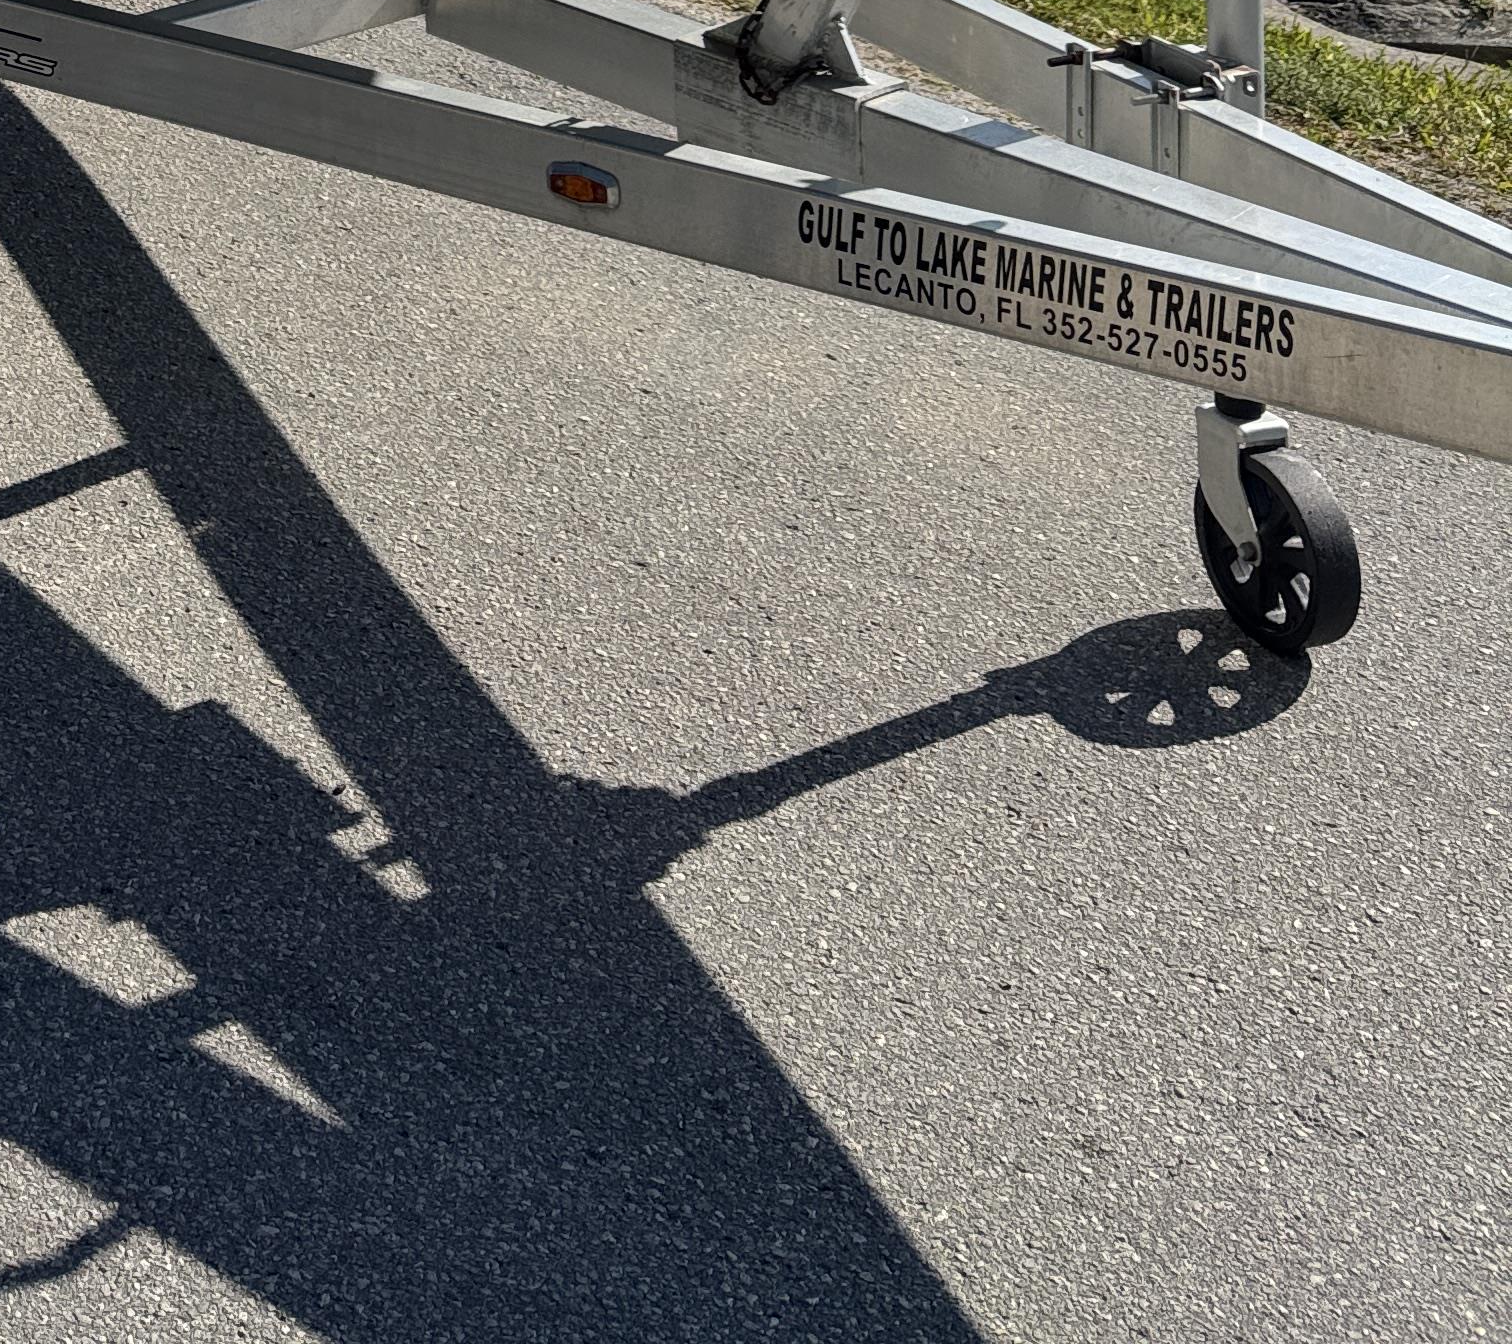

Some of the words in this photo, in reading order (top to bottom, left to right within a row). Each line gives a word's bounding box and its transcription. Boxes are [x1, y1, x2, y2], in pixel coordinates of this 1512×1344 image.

[798, 199, 866, 253] GULF
[874, 216, 907, 265] TO
[916, 226, 987, 285] LAKE
[995, 245, 1107, 312] MARINE
[1116, 273, 1135, 320] &
[1146, 279, 1295, 358] TRAILERS
[837, 257, 985, 324] LECANTO,
[996, 297, 1032, 330] FL
[1042, 308, 1248, 381] 352-527-0555
